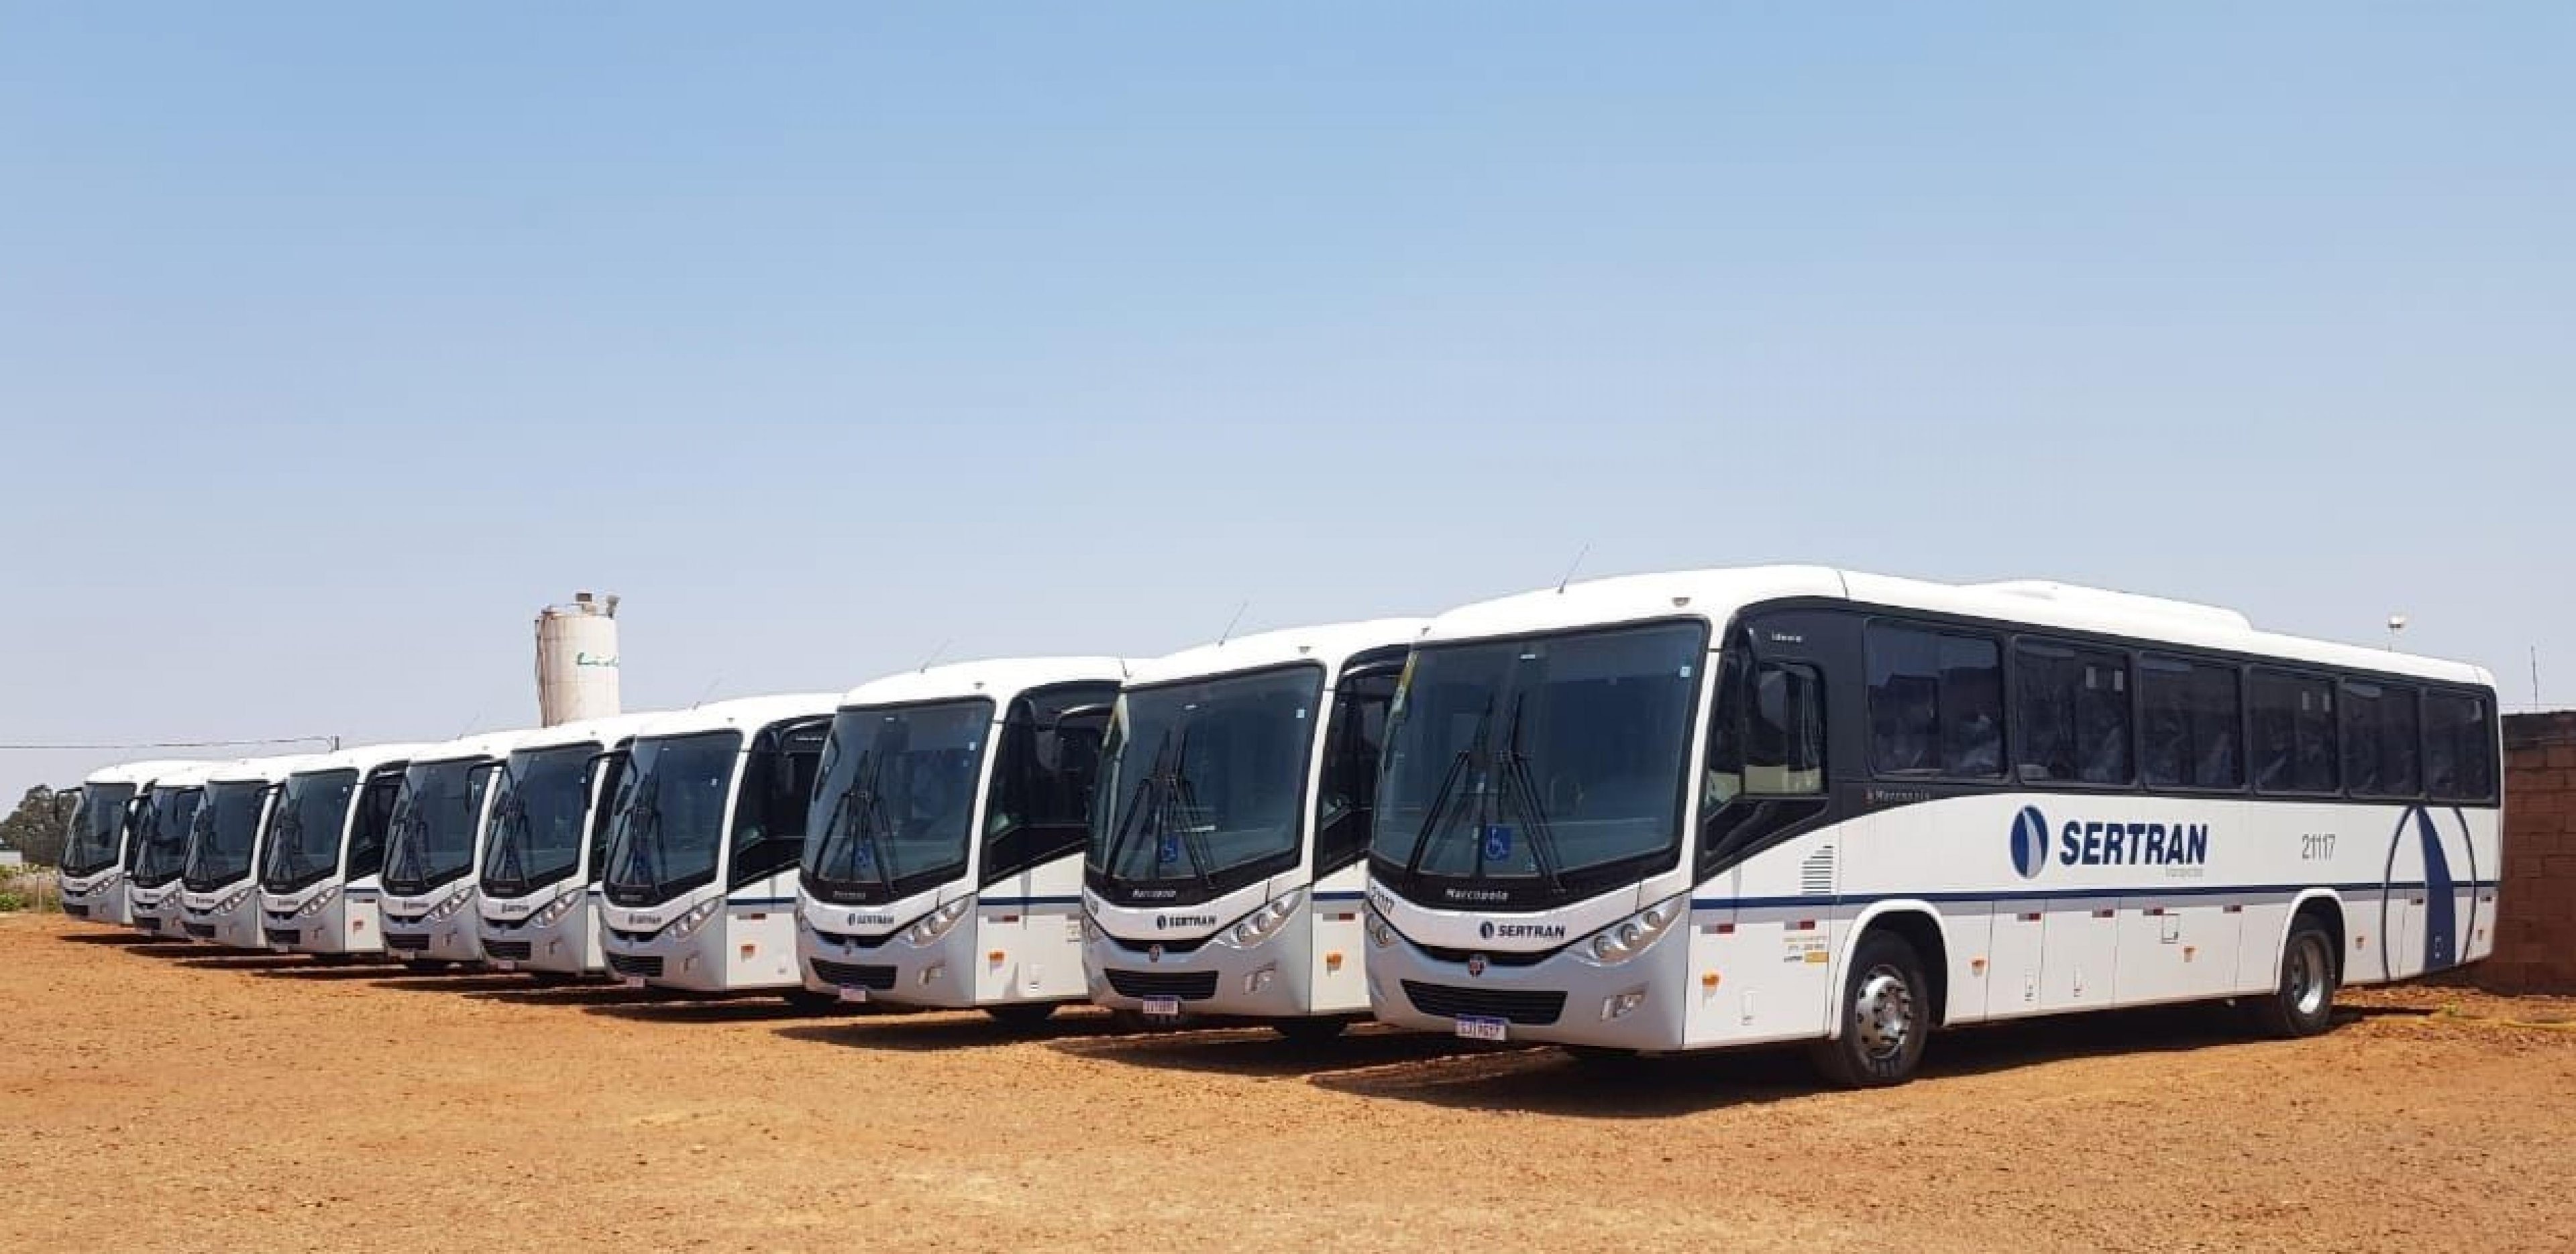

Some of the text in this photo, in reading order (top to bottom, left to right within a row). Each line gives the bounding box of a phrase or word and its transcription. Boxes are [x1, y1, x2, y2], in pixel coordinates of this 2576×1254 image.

[2059, 820, 2208, 866] SERTRAN
[2302, 833, 2336, 861] 21117
[1498, 924, 1566, 939] SERTRAN
